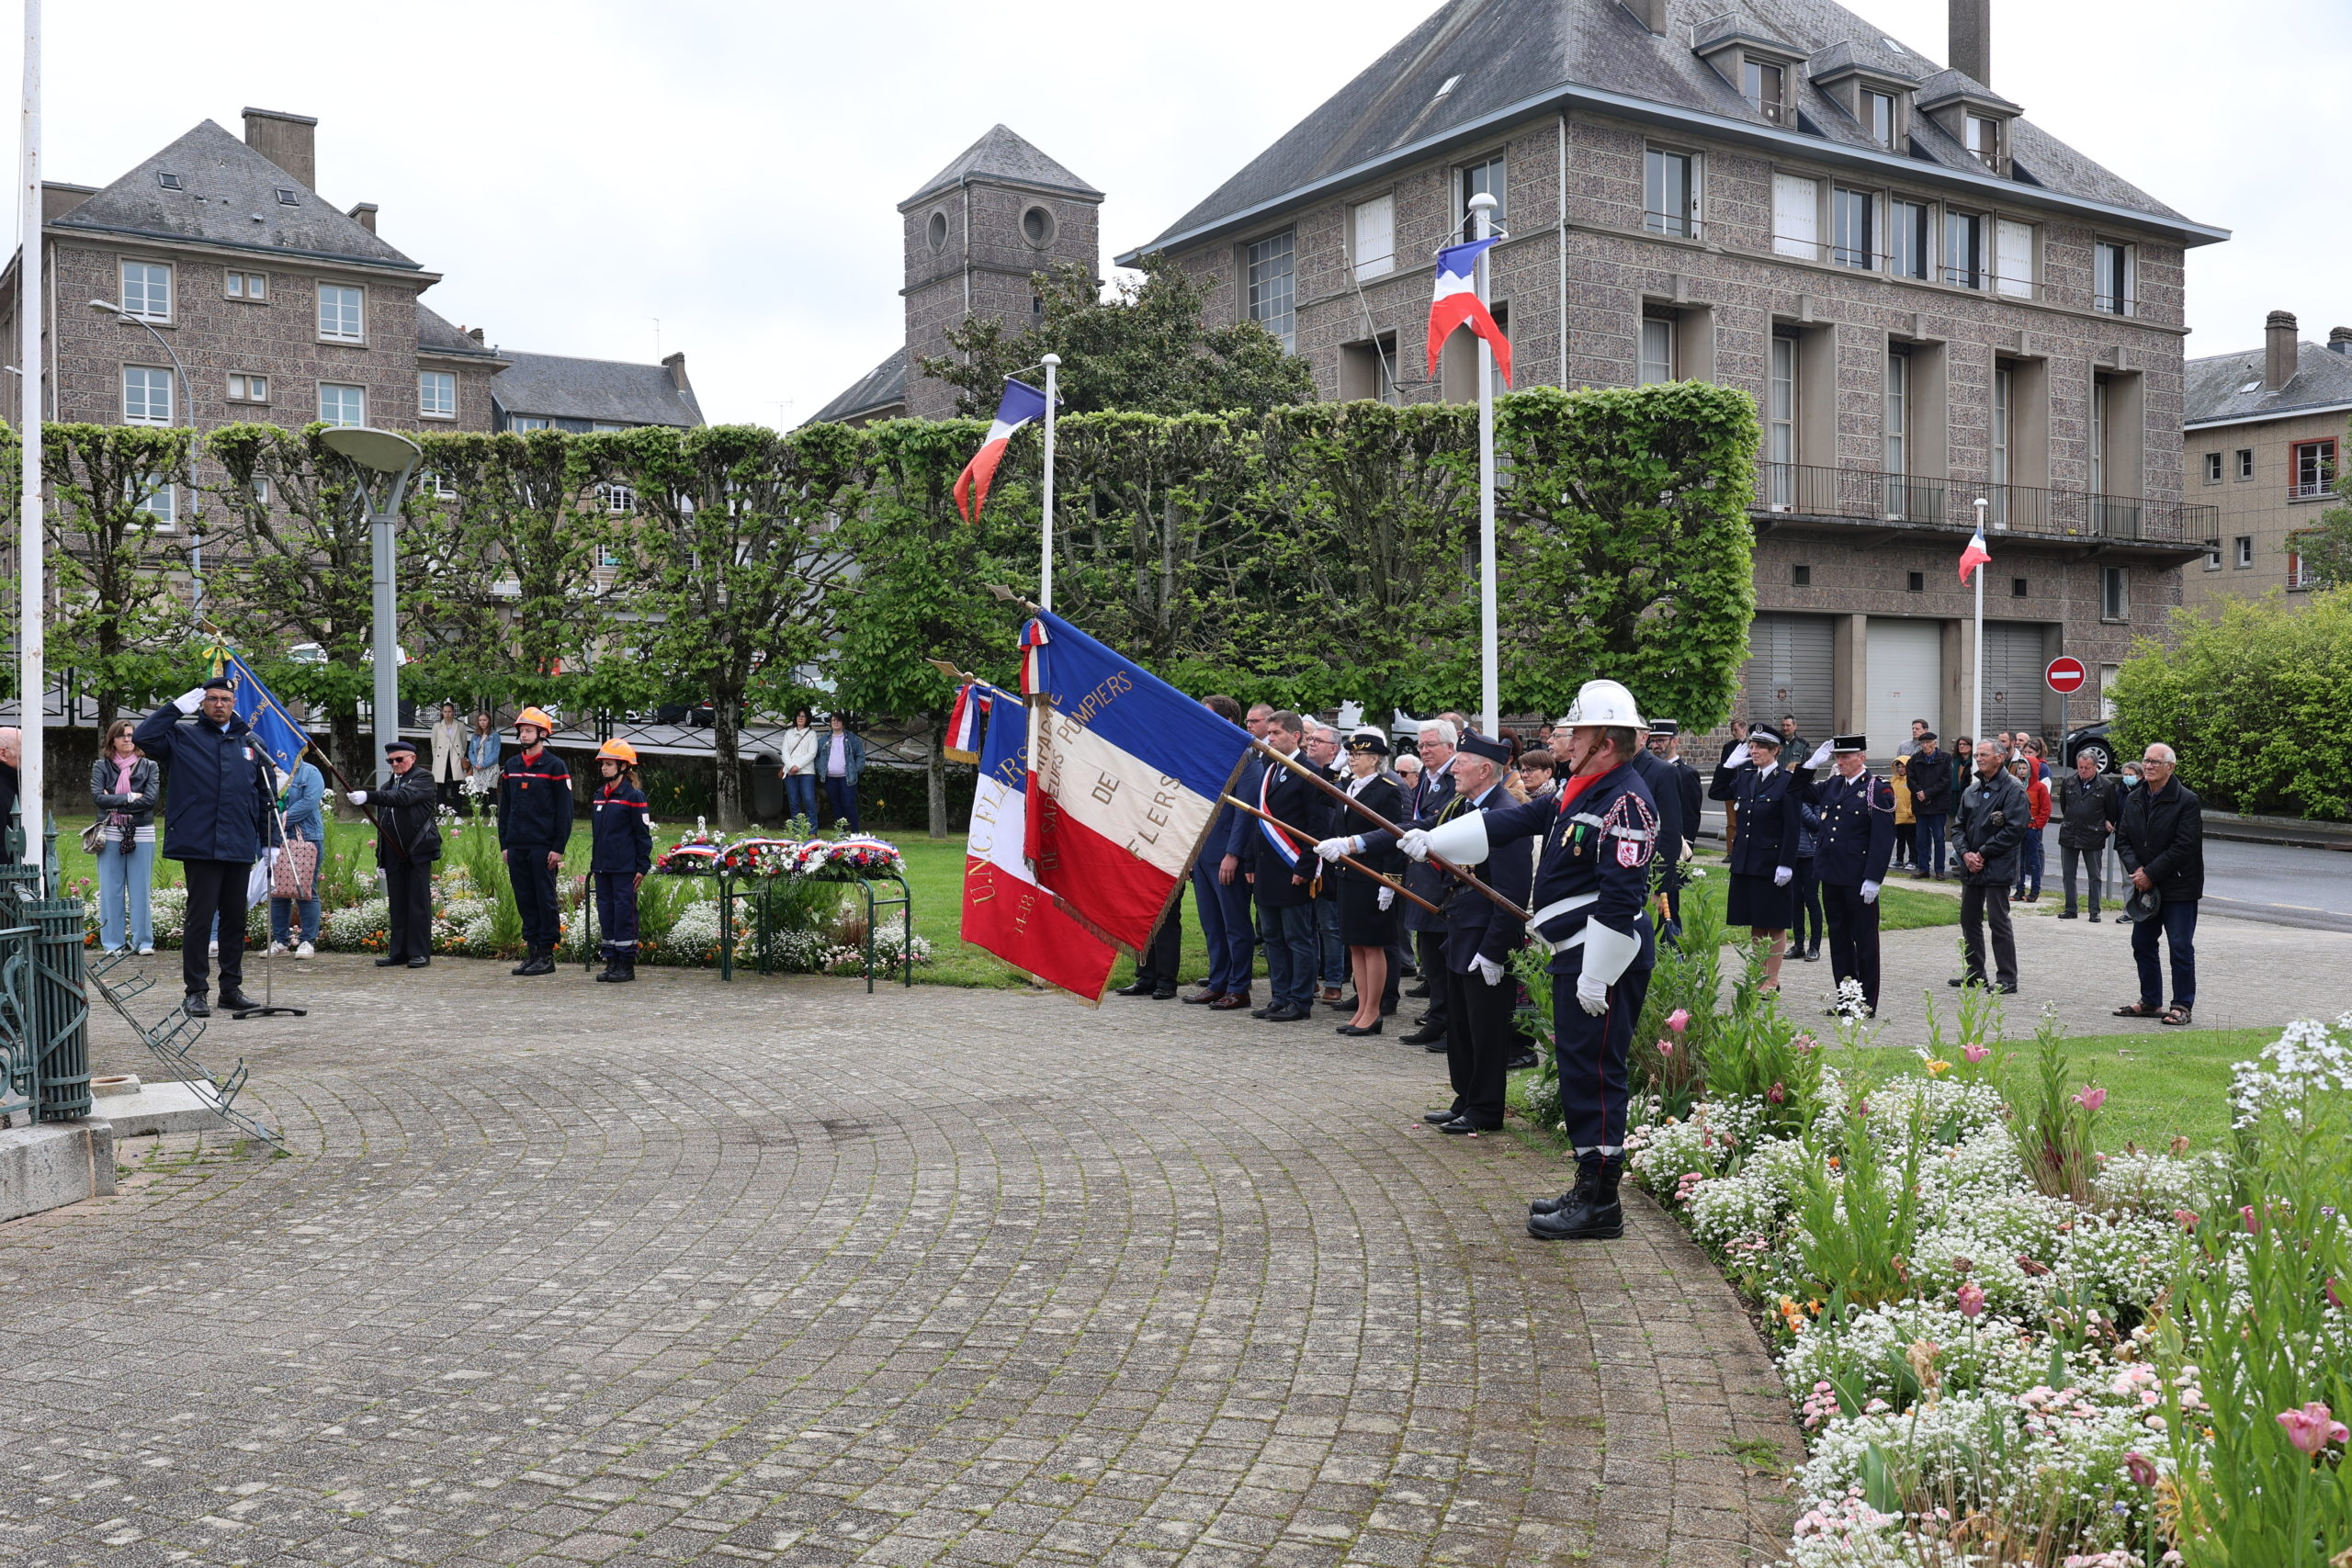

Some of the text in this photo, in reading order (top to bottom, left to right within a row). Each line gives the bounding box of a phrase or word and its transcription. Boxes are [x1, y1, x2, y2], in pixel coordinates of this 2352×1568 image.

[247, 697, 269, 729] SCIPLINE
[1036, 694, 1063, 776] MPAGNIE
[1041, 671, 1133, 871] DE SAPEURS POMPIERS
[1091, 772, 1121, 806] DE
[1126, 775, 1182, 862] FLERS
[1013, 895, 1035, 937] 14-18
